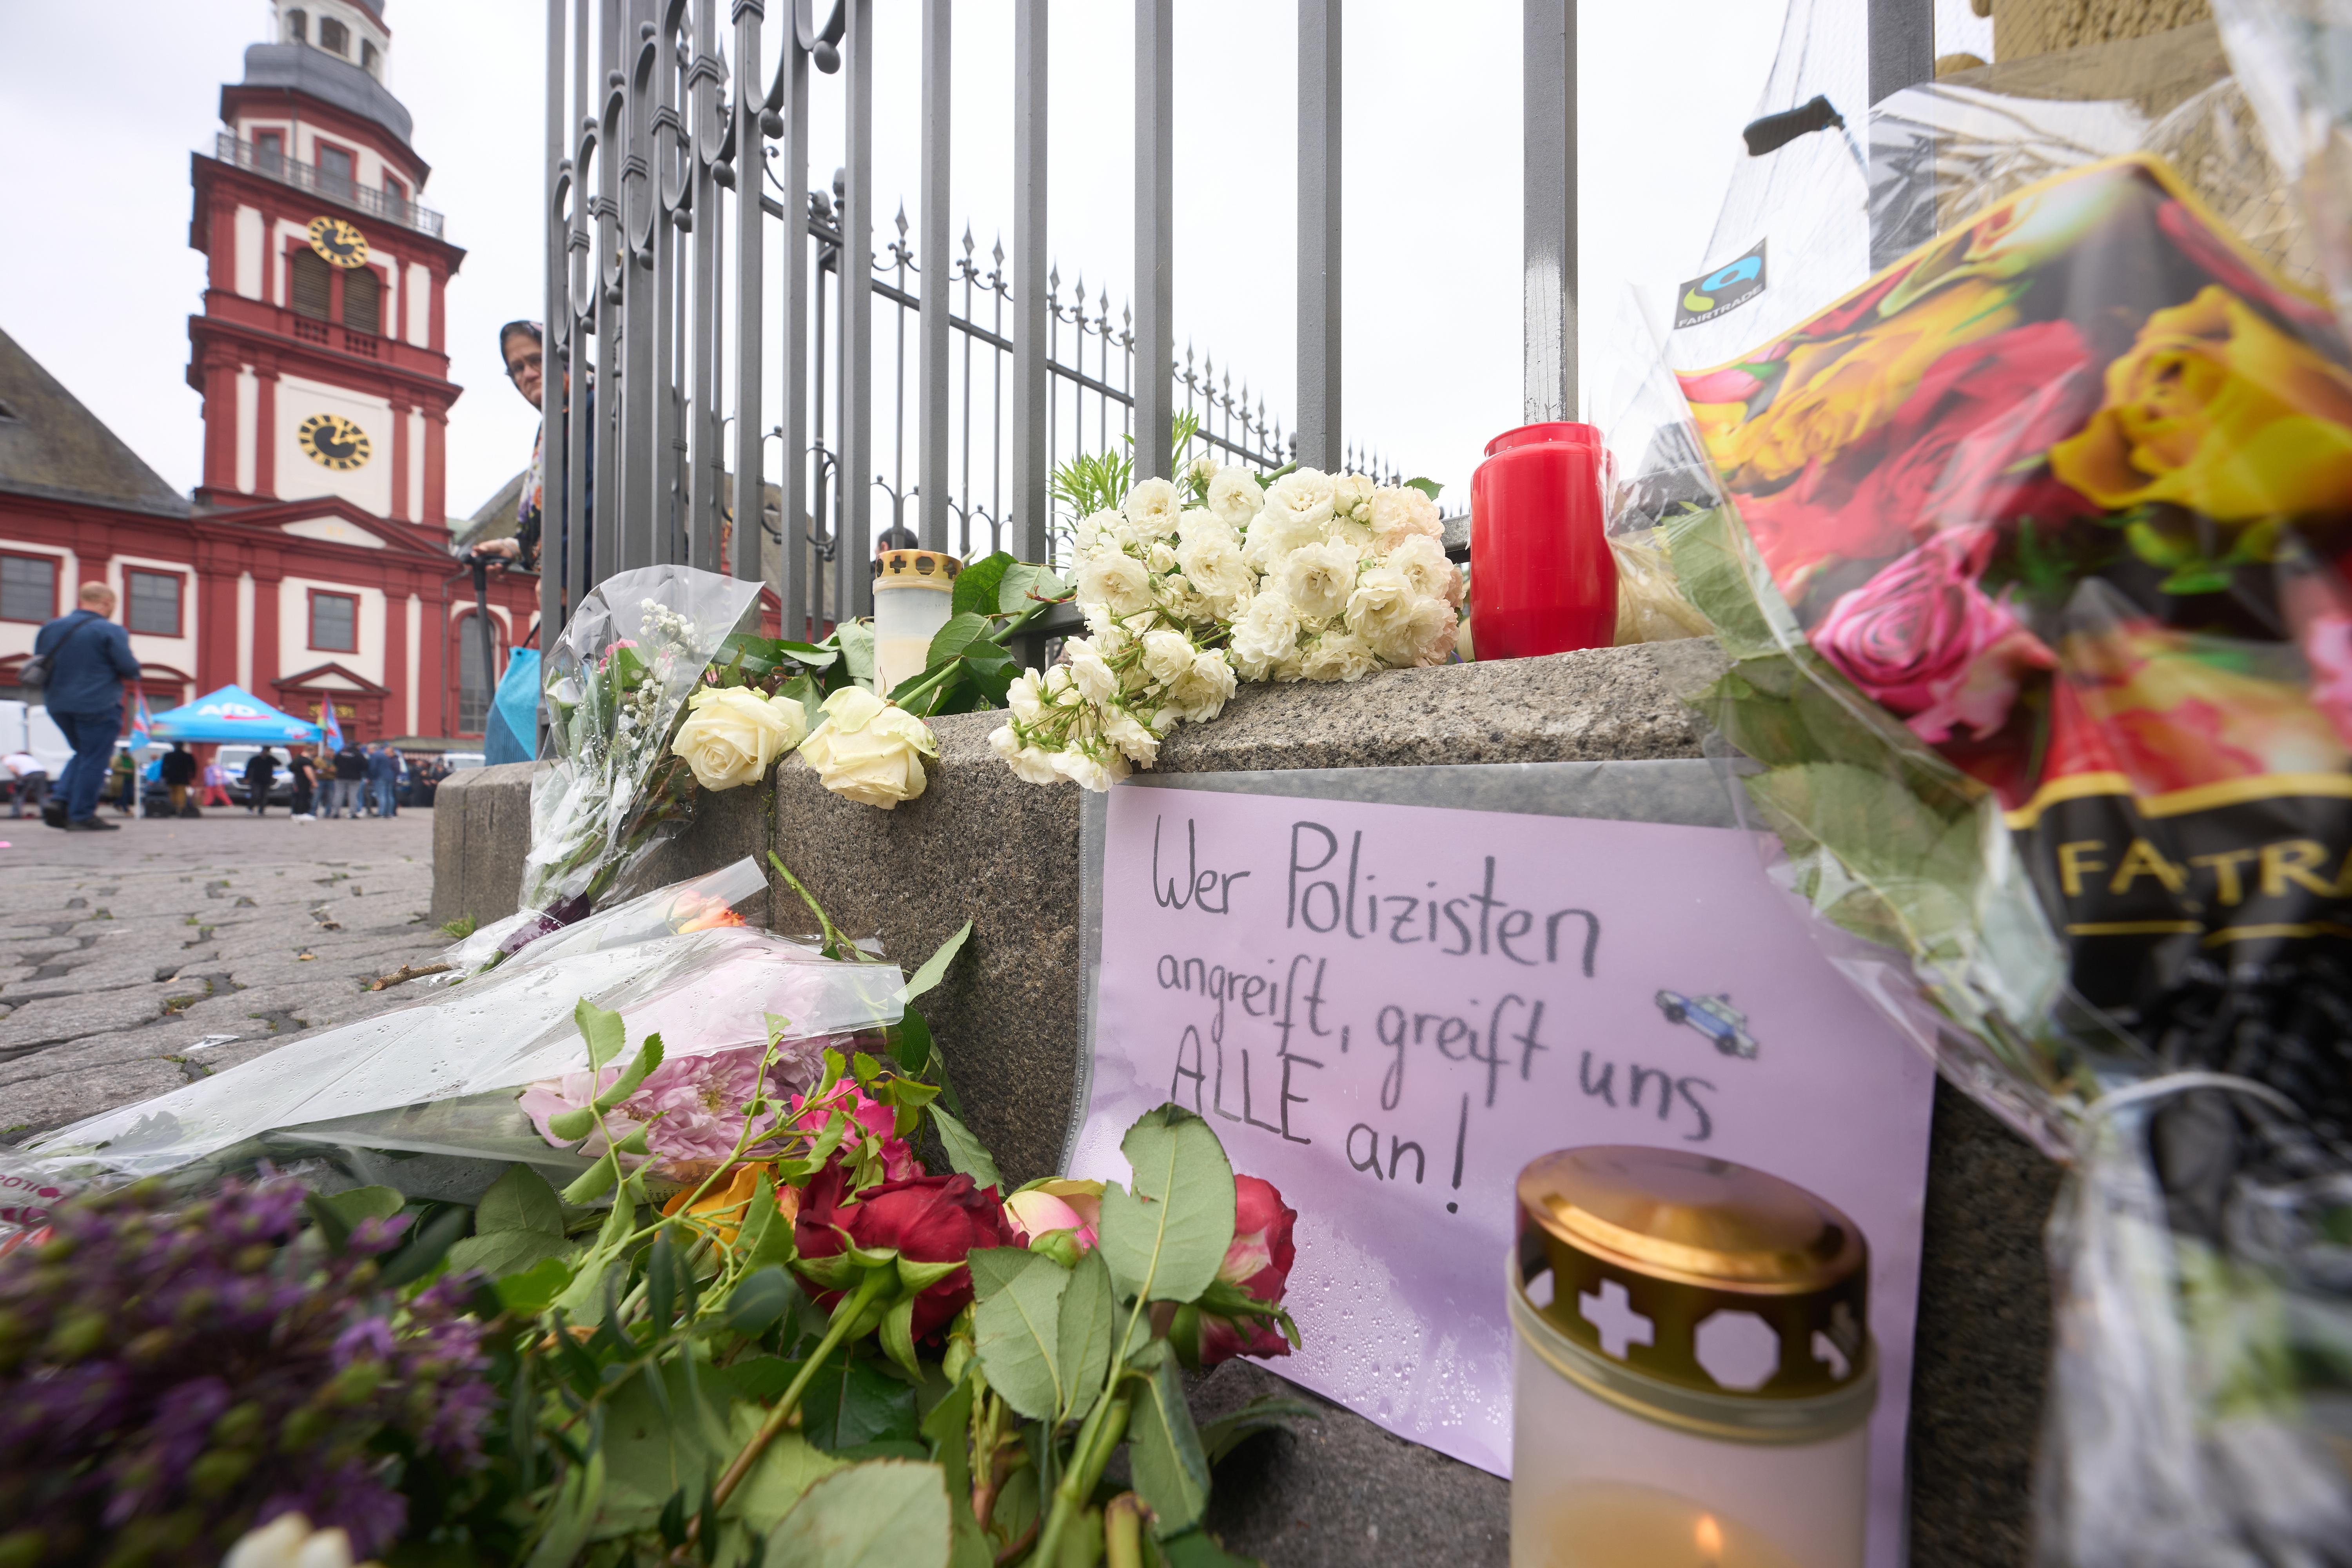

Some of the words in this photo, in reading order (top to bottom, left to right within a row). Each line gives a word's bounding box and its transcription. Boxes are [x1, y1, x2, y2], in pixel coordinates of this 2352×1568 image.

[1678, 283, 1763, 328] FAIRTRADE
[198, 702, 257, 716] AfD
[1152, 814, 1251, 916] Wer
[1286, 820, 1601, 978] Polizisten
[1156, 954, 1351, 1057] angreift,
[1376, 994, 1548, 1111] greift
[1579, 1051, 1719, 1142] uns
[1171, 1024, 1325, 1145] ALLE
